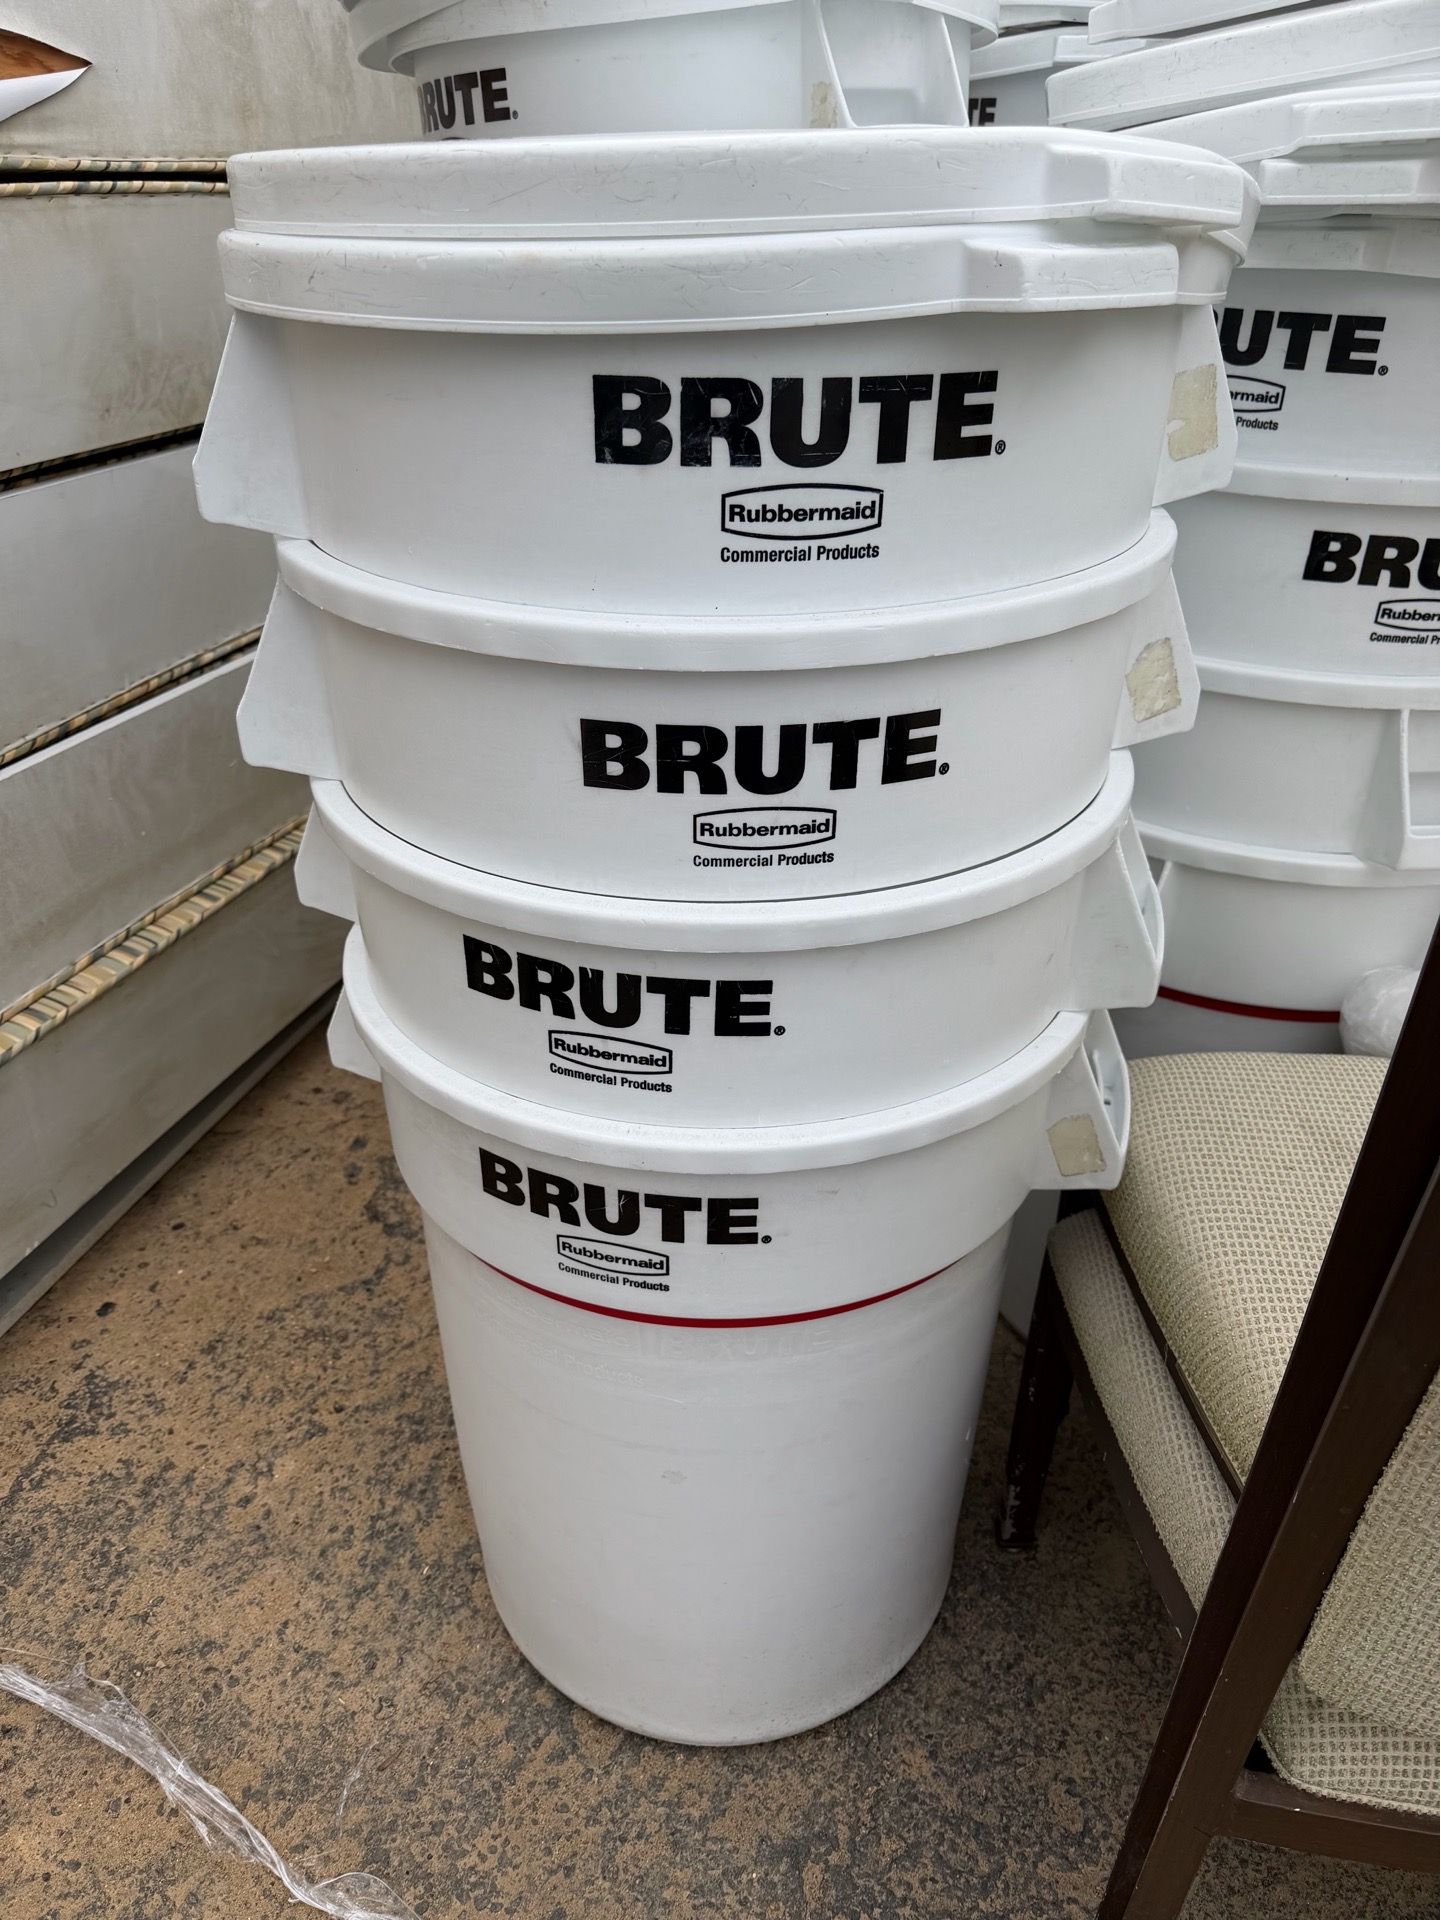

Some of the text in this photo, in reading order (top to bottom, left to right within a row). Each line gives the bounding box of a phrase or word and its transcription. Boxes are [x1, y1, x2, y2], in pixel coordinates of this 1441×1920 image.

[1235, 415, 1279, 431] Products
[728, 500, 877, 524] Rubbermaid
[720, 543, 880, 563] Commercial Products
[1369, 631, 1429, 645] Commercial
[699, 817, 831, 838] Rubbermaid
[693, 851, 835, 868] Commercial Products
[553, 1037, 667, 1068] Rubbermaid
[549, 1062, 673, 1093] Commercial Products
[561, 1240, 665, 1271] Rubbermaid
[558, 1261, 670, 1292] Commercial Products
